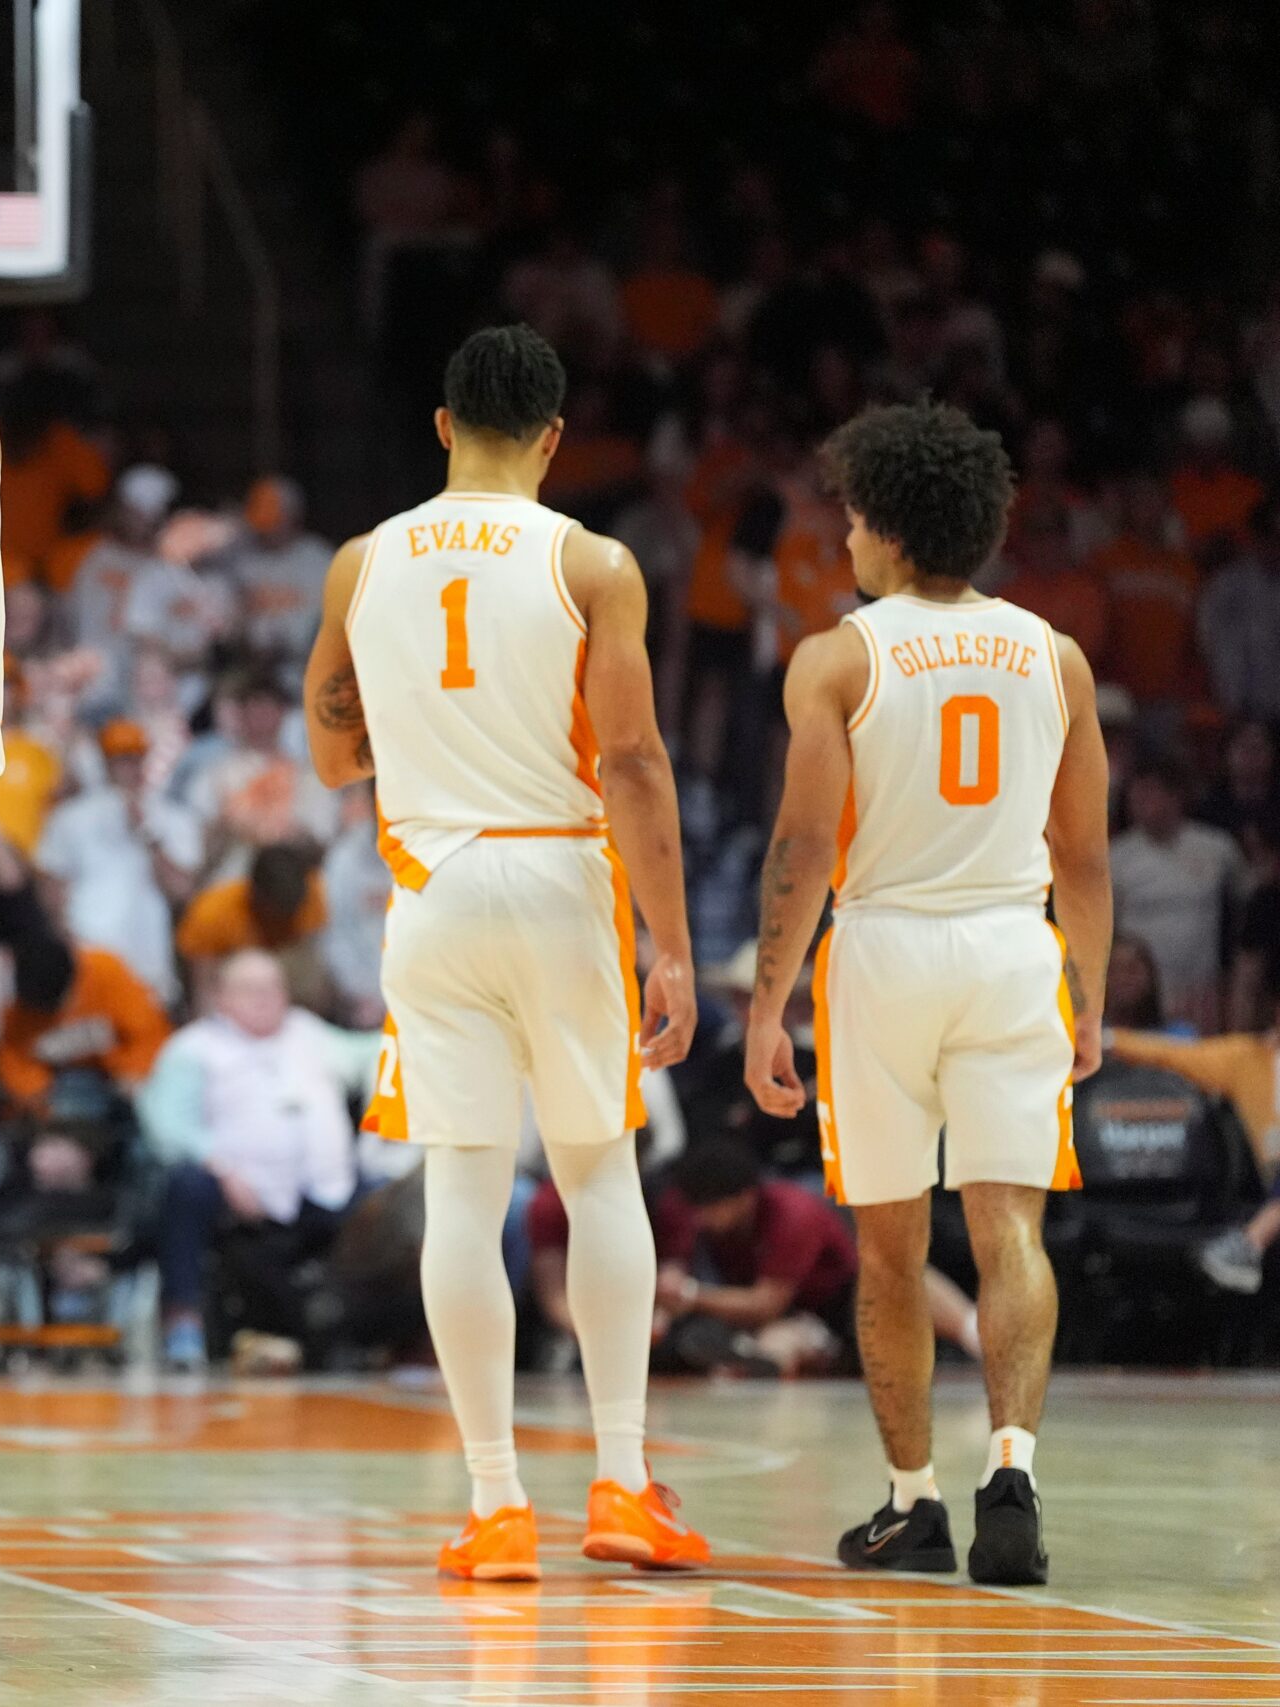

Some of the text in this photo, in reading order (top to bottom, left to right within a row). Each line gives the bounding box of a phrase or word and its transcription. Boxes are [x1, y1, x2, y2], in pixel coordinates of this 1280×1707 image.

[408, 521, 521, 557] EVANS
[439, 577, 477, 691] 1
[891, 632, 1038, 679] GILLESPIE
[938, 694, 1001, 807] 0
